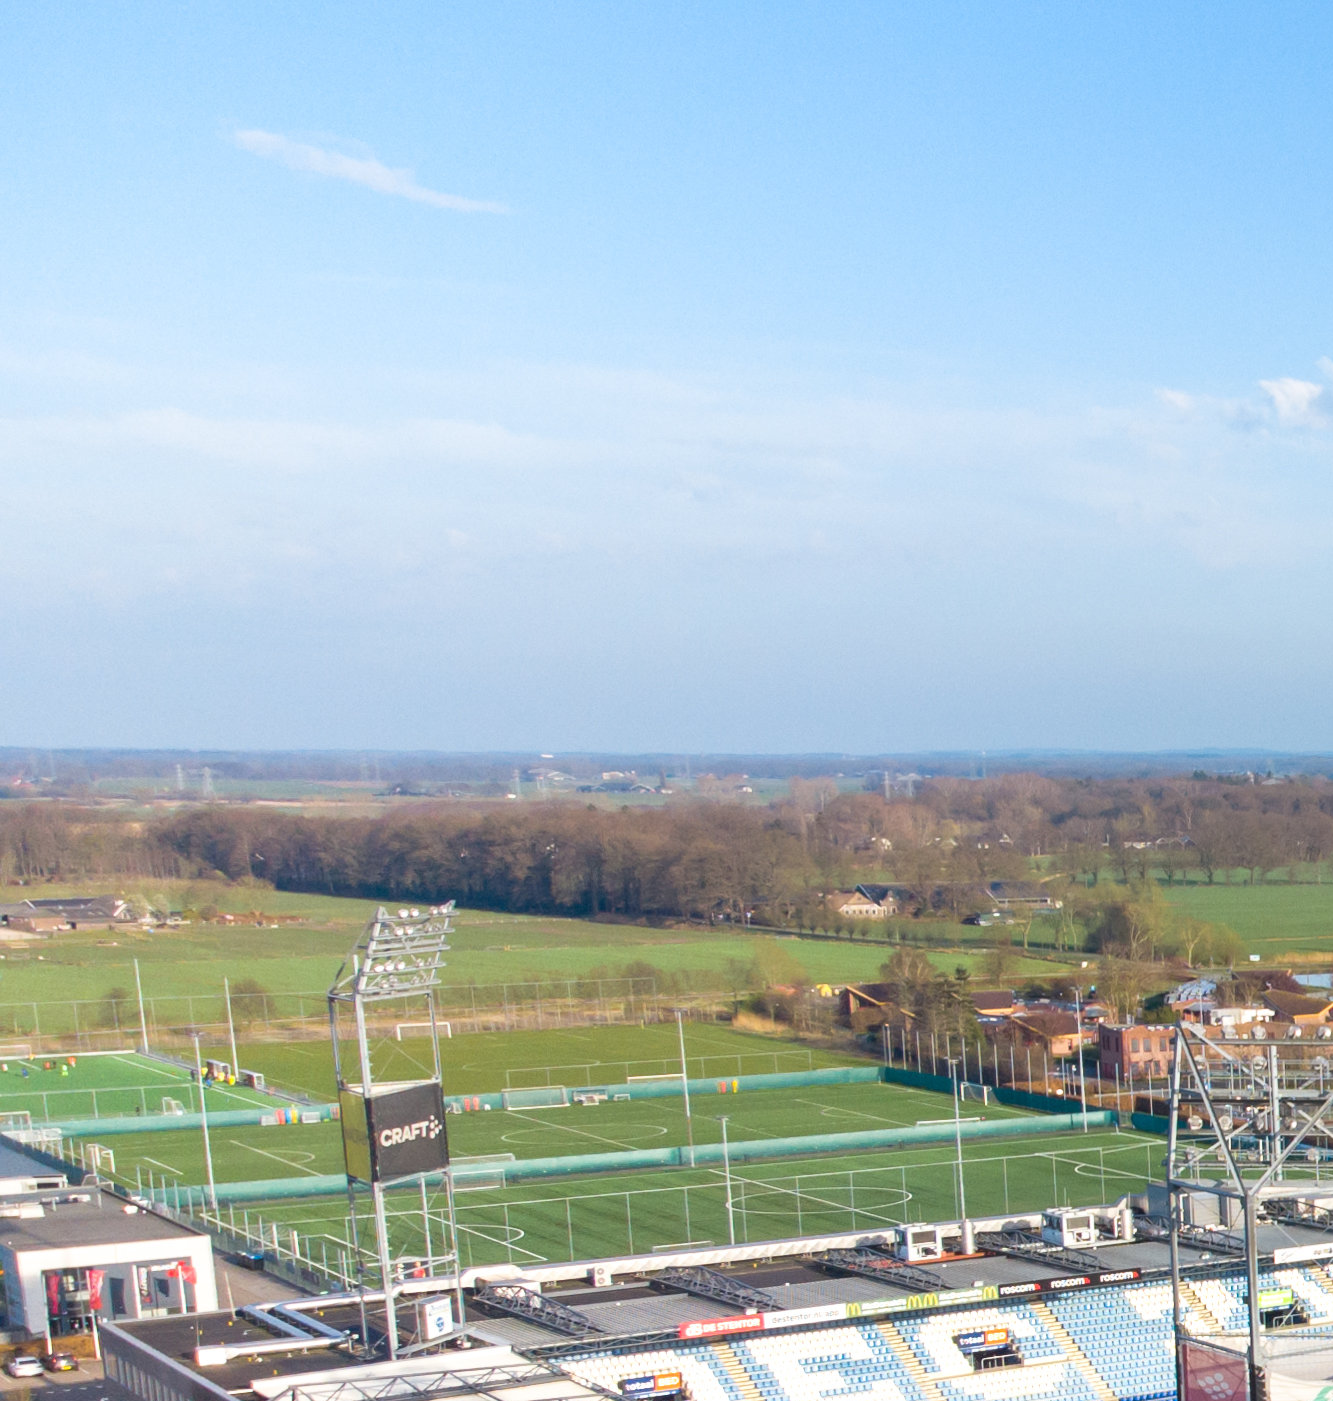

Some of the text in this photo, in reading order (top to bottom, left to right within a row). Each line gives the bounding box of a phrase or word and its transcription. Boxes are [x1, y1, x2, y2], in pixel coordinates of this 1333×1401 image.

[379, 1120, 429, 1147] CRAFT
[1050, 1276, 1085, 1289] roscom
[1100, 1270, 1134, 1283] roscom
[1000, 1283, 1035, 1295] roscom
[717, 1317, 761, 1332] STENTOR
[959, 1332, 1007, 1346] totaal BED
[624, 1375, 679, 1392] totaal BED
